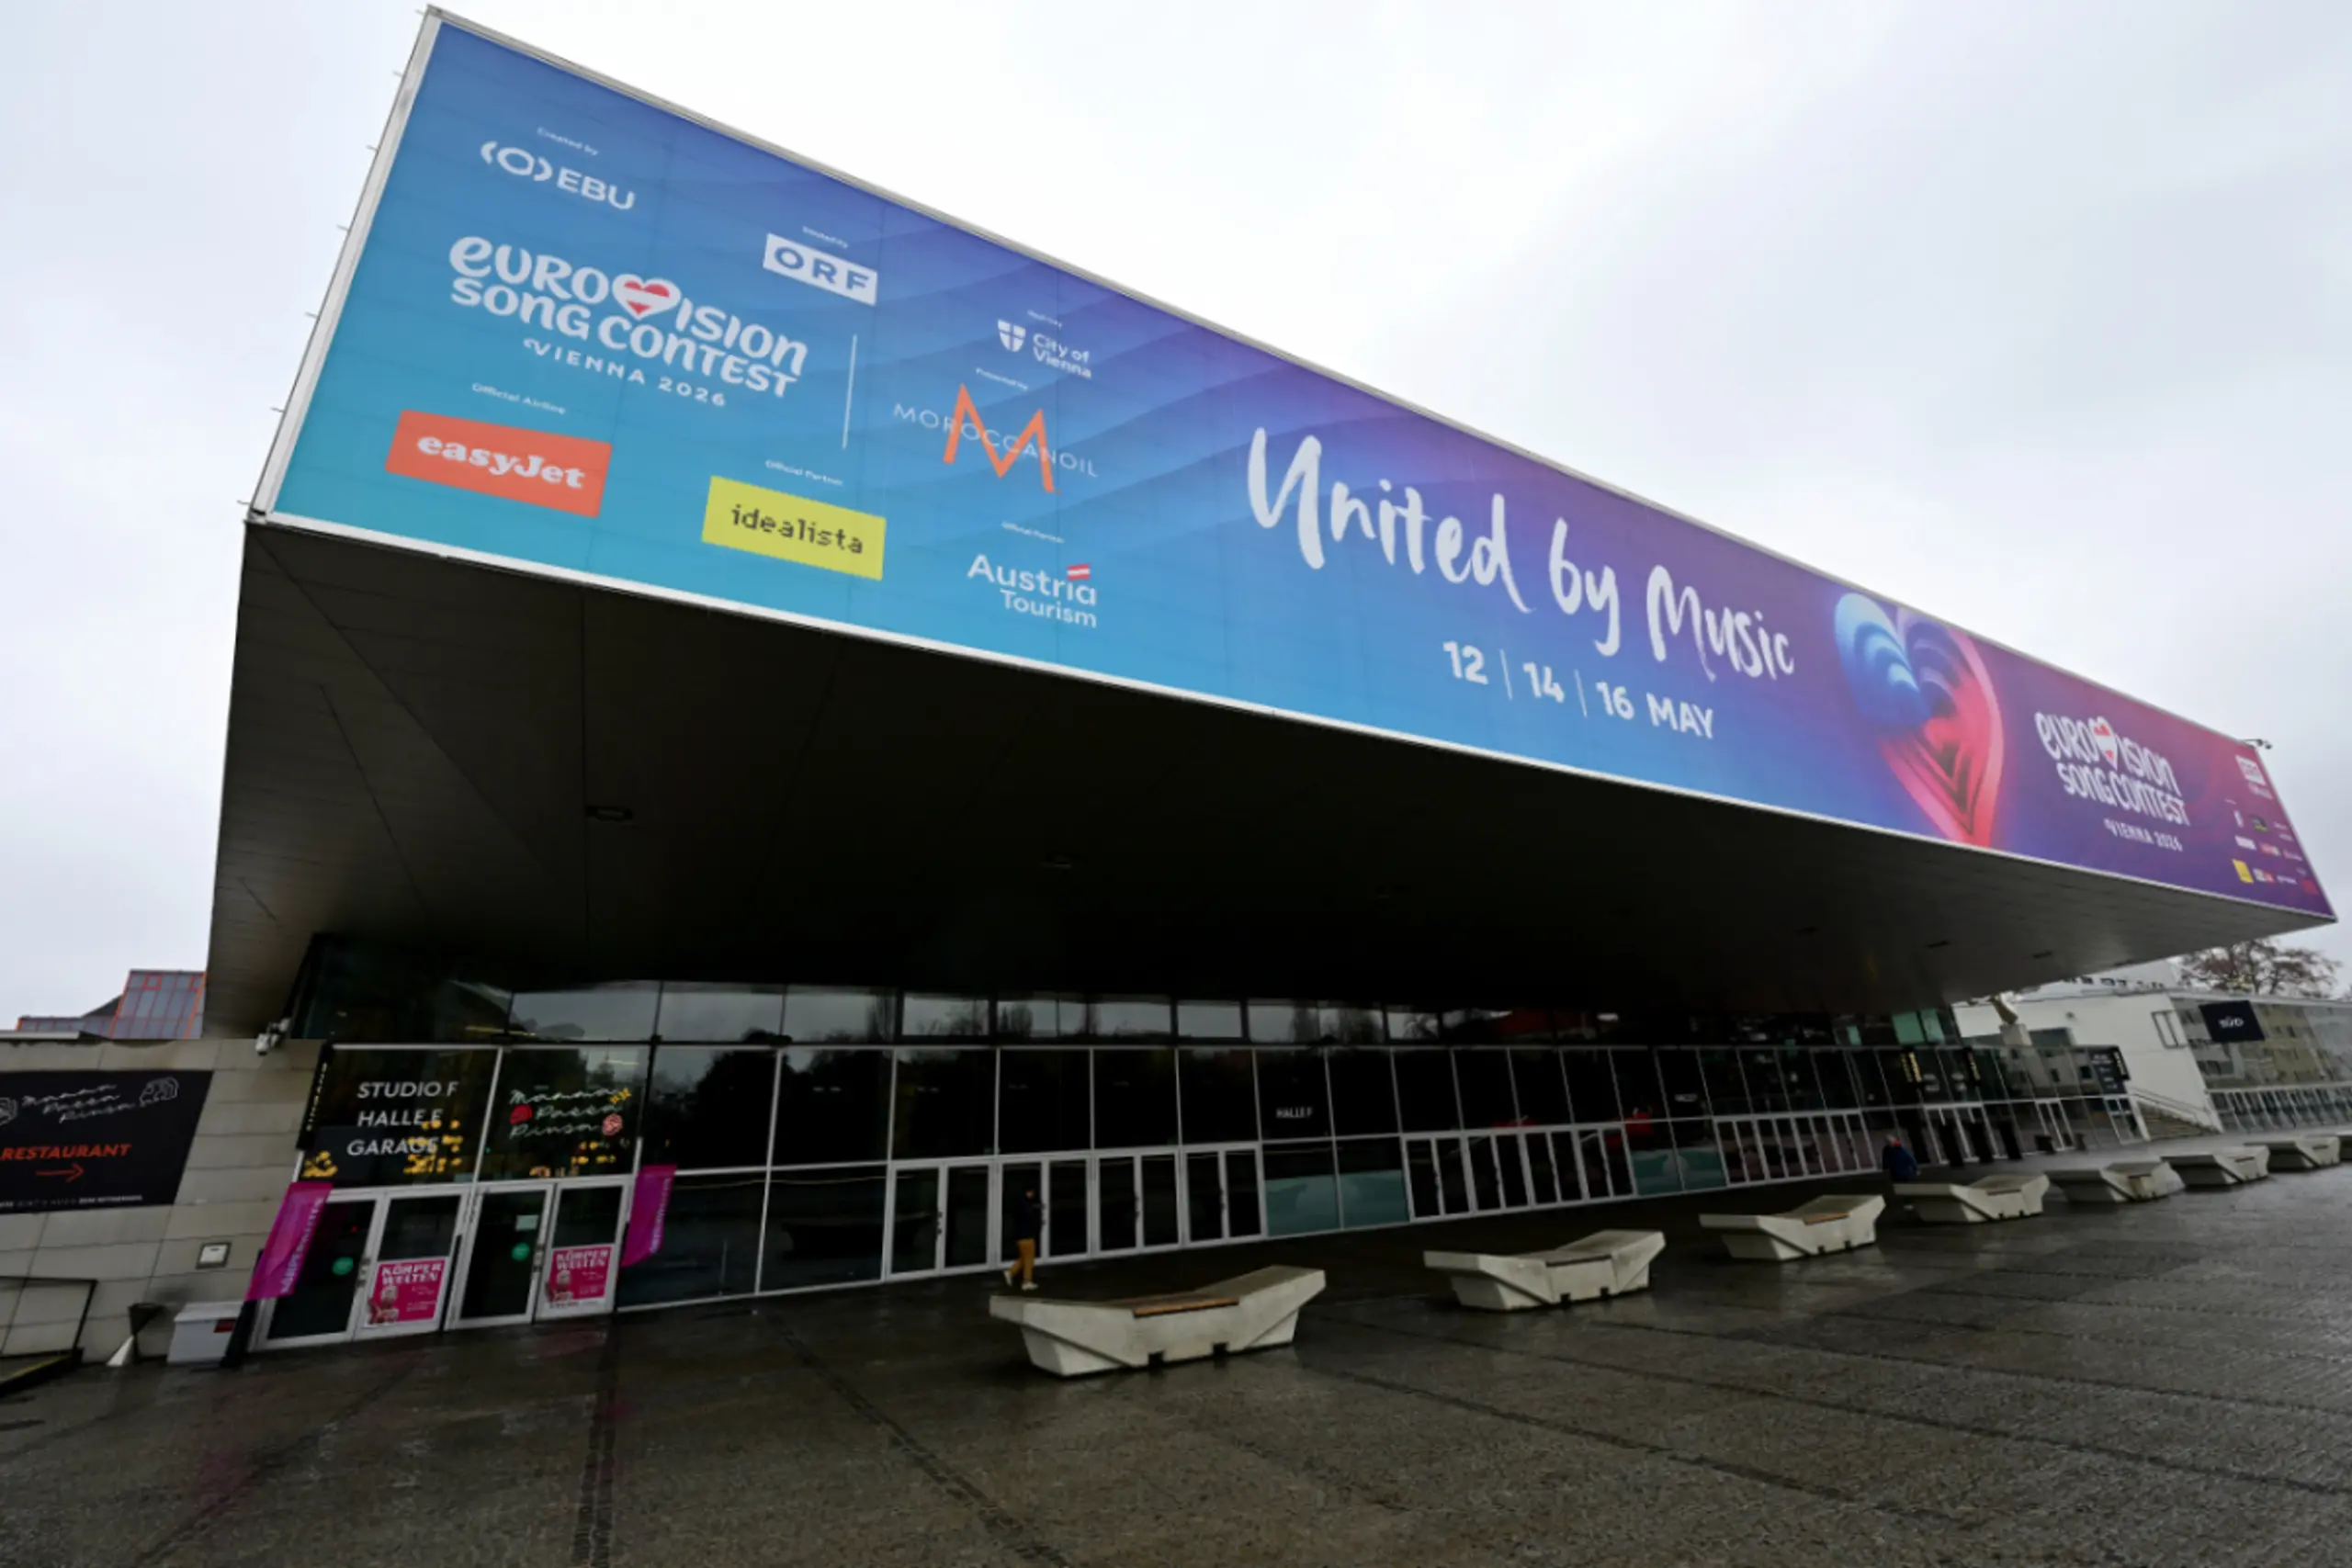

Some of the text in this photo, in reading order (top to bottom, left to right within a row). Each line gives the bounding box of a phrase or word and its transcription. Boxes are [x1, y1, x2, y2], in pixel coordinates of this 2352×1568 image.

[557, 166, 636, 210] EBU
[774, 245, 872, 293] ORF
[1033, 333, 1090, 364] City of
[1033, 346, 1091, 379] Vienna
[471, 382, 520, 402] Official
[523, 337, 726, 407] VIENNA 2026
[893, 403, 1099, 478] MOROCCANOIL
[417, 436, 586, 489] easyJet
[731, 504, 865, 555] idealista
[1248, 427, 1795, 682] United by Music
[967, 554, 1096, 606] Austria
[1000, 588, 1097, 628] Tourism
[1442, 640, 1715, 739] 12 14 16 MAY
[2104, 818, 2184, 852] VIENNA 2026
[356, 1081, 459, 1099] STUDIO F
[356, 1109, 427, 1128] HALLE
[0, 1144, 132, 1161] RESTAURANT
[346, 1136, 440, 1156] GARAGE
